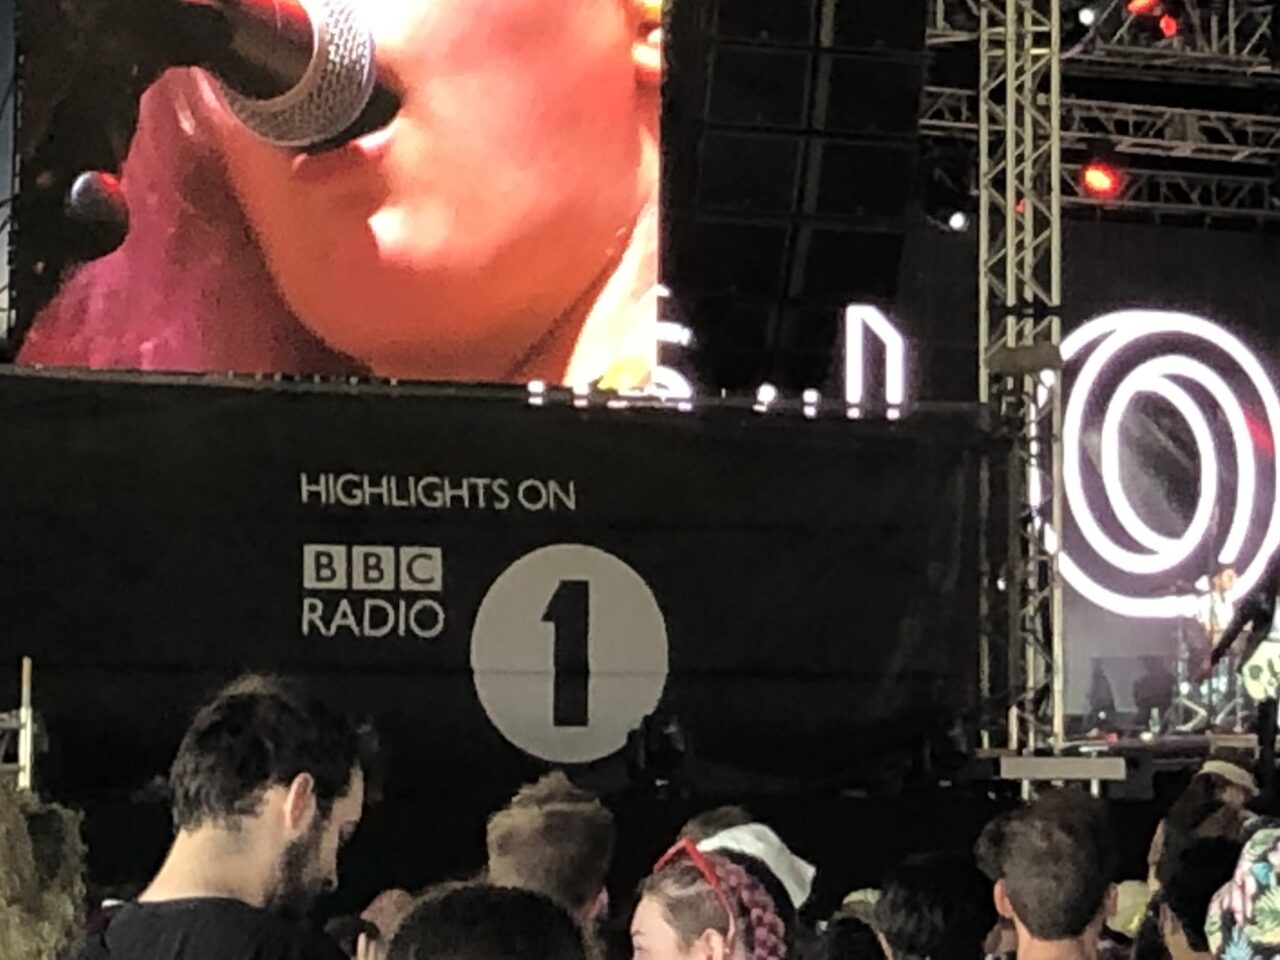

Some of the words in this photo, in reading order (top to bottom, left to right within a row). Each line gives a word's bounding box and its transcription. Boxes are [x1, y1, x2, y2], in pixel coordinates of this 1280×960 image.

[301, 473, 510, 510] HIGHLIGHTS
[518, 479, 576, 511] ON
[309, 547, 438, 587] BBC
[303, 599, 445, 638] RADIO
[540, 580, 589, 727] 1
